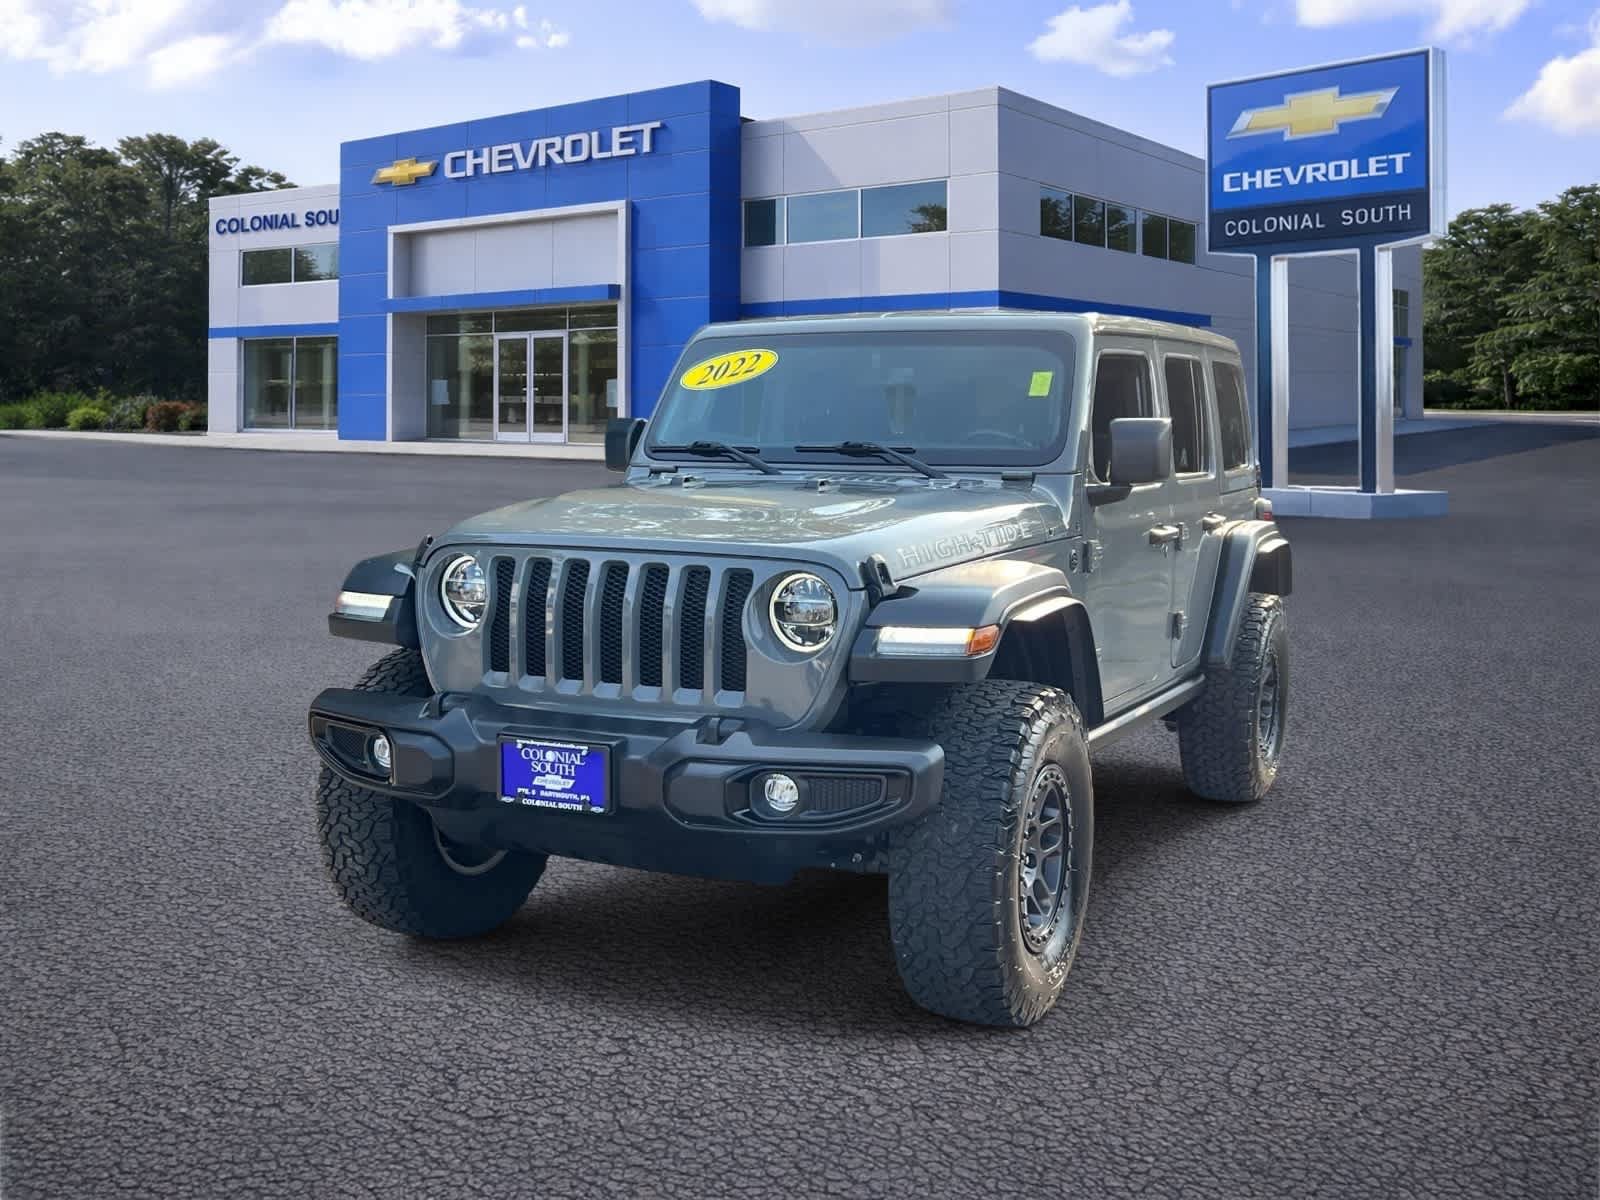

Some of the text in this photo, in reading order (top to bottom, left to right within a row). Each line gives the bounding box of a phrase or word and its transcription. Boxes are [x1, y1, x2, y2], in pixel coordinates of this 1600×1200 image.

[443, 121, 663, 179] CHEVROLET
[1223, 152, 1411, 192] CHEVROLET
[215, 213, 300, 235] COLONIAL
[1224, 204, 1412, 237] COLONIAL SOUTH
[696, 353, 761, 386] 2022
[900, 533, 973, 569] HIGH
[521, 747, 586, 766] COLONIAL
[531, 761, 576, 776] SOUTH
[522, 798, 582, 811] COLONIAL SOUTH
